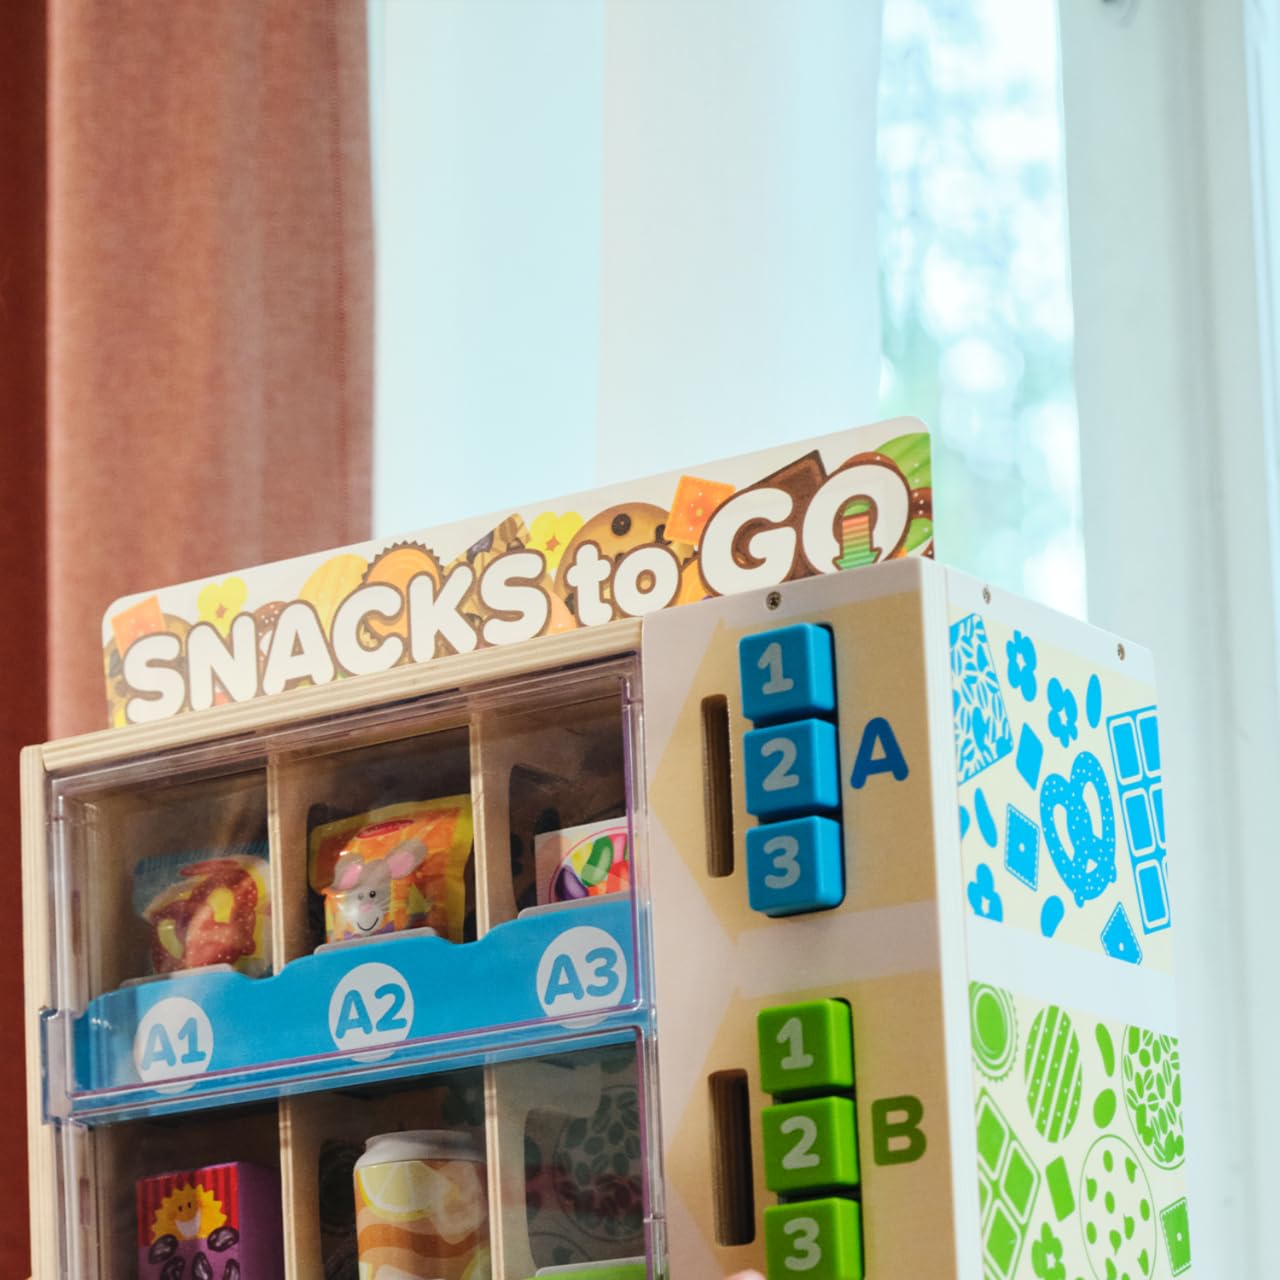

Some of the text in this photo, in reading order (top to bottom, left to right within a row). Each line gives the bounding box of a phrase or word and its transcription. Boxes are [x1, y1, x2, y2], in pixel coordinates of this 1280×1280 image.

[123, 462, 910, 726] SNACKS to GO
[757, 642, 794, 696] 1
[760, 736, 800, 793] 2
[850, 717, 909, 789] A
[763, 835, 801, 890] 3
[543, 946, 620, 1005] A3
[334, 982, 408, 1040] A2
[140, 1016, 208, 1072] A1
[775, 1016, 814, 1070] 1
[779, 1115, 820, 1170] 2
[871, 1095, 927, 1166] B
[783, 1217, 821, 1272] 3
